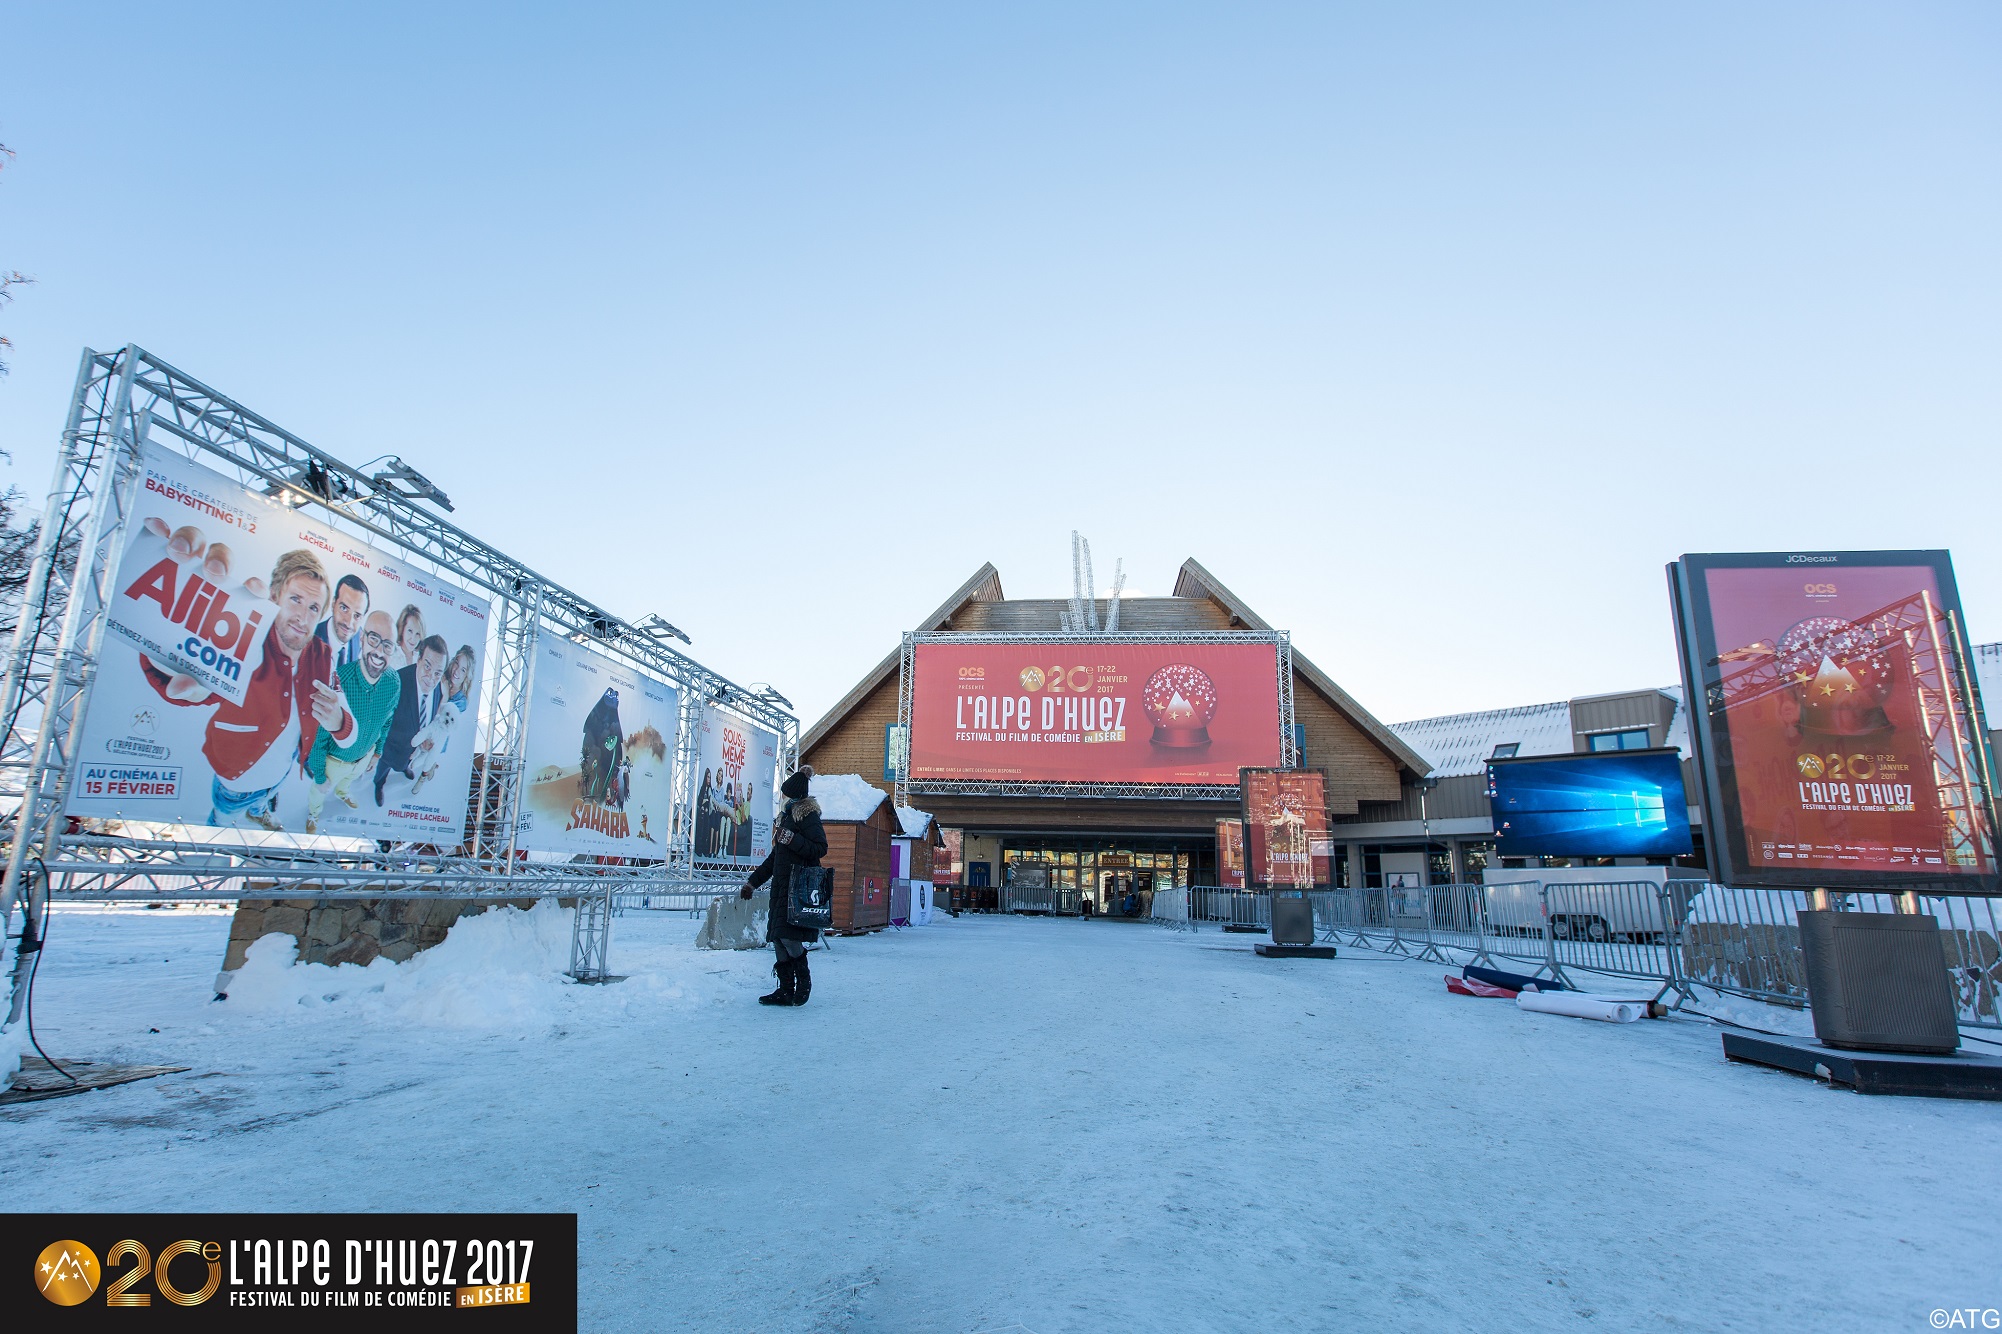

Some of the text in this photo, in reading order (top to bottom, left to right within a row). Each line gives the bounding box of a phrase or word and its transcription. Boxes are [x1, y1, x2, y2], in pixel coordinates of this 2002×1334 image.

[145, 478, 234, 525] BABYSITTING
[147, 469, 259, 523] PAR LES CRÉATEURS DE
[299, 531, 335, 553] LACHEAU
[341, 551, 371, 569] FONTAN
[1785, 554, 1838, 563] JCDecaux
[377, 567, 401, 583] ARRUTI
[406, 580, 433, 597] BOUDALI
[1804, 583, 1837, 594] OCS
[439, 595, 454, 606] BAYE
[124, 557, 263, 662] Alibi
[459, 604, 485, 620] BOURDON
[176, 636, 242, 682] .com
[168, 652, 178, 663] ON
[179, 657, 209, 682] S'OCCUPE
[210, 675, 219, 686] DE
[220, 680, 235, 694] TOUT
[958, 667, 985, 677] OCS
[1096, 665, 1116, 673] 17-22
[1096, 685, 1114, 693] 2017
[723, 727, 742, 748] SOUS
[741, 739, 746, 749] LE
[956, 731, 1123, 743] FESTIVAL DU FILM DE COMÉDIE EN ISÈRE
[1876, 754, 1896, 762] 17-22
[86, 768, 177, 781] AU CINÉMA LE
[725, 761, 742, 781] TOIT
[86, 780, 175, 795] 15 FÉVRIER
[412, 804, 433, 813] COMÉDIE
[1802, 803, 1828, 811] FESTIVAL
[1860, 803, 1886, 812] COMÉDIE
[1894, 804, 1914, 812] ISÈRE
[387, 809, 450, 823] PHILIPPE LACHEAU
[566, 798, 631, 839] SAHARA
[520, 820, 532, 831] FÉV.
[801, 907, 830, 915] SCOTT
